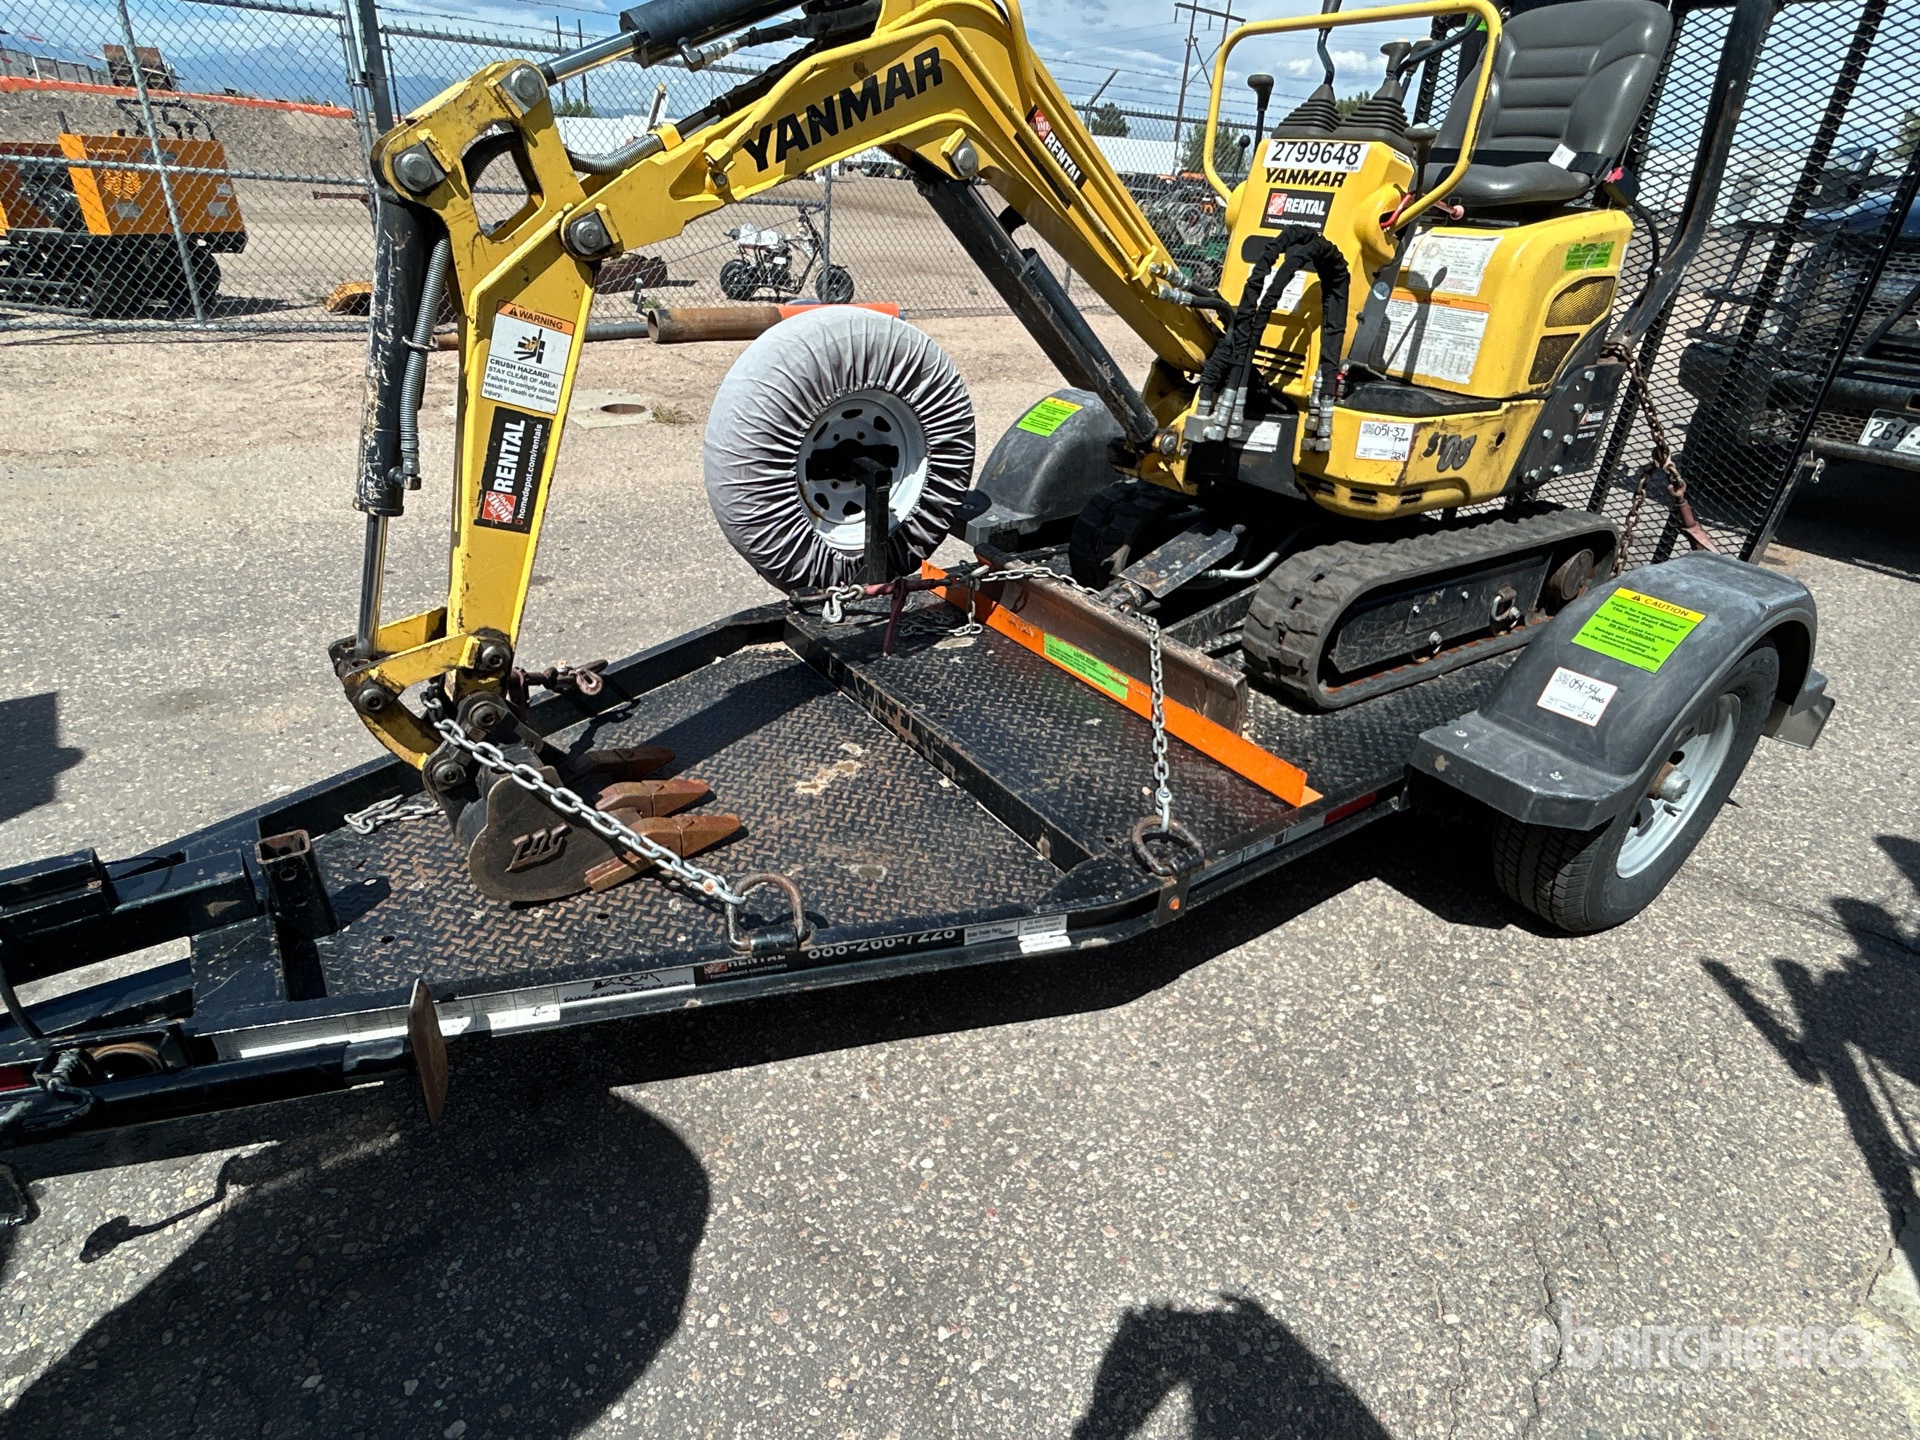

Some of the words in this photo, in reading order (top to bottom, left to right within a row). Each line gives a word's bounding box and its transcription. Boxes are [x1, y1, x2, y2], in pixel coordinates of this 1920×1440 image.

[742, 47, 943, 172] YANMAR
[1271, 141, 1361, 165] 2799648
[1265, 167, 1347, 188] YANMAR
[1283, 198, 1326, 216] RENTAL
[519, 310, 563, 330] WARNING
[488, 366, 506, 375] STAY
[506, 370, 529, 381] CLEAR
[490, 358, 516, 371] CRUSH
[517, 366, 550, 380] HAZARD!
[487, 373, 508, 384] Failure
[515, 381, 538, 393] comply
[538, 387, 555, 396] could
[510, 388, 528, 397] death
[535, 394, 557, 405] serious
[1374, 424, 1406, 437] 051-37
[493, 420, 526, 493] RENTAL
[516, 423, 543, 519] homedepot.com/rentals
[1643, 598, 1689, 616] CAUTION
[1623, 610, 1641, 618] Home
[1640, 616, 1659, 625] Depot
[1658, 622, 1679, 631] Rental
[1636, 610, 1678, 627] transportation
[1593, 626, 1615, 636] Damage
[1643, 630, 1665, 640] Carrying
[1569, 679, 1601, 694] 051-54
